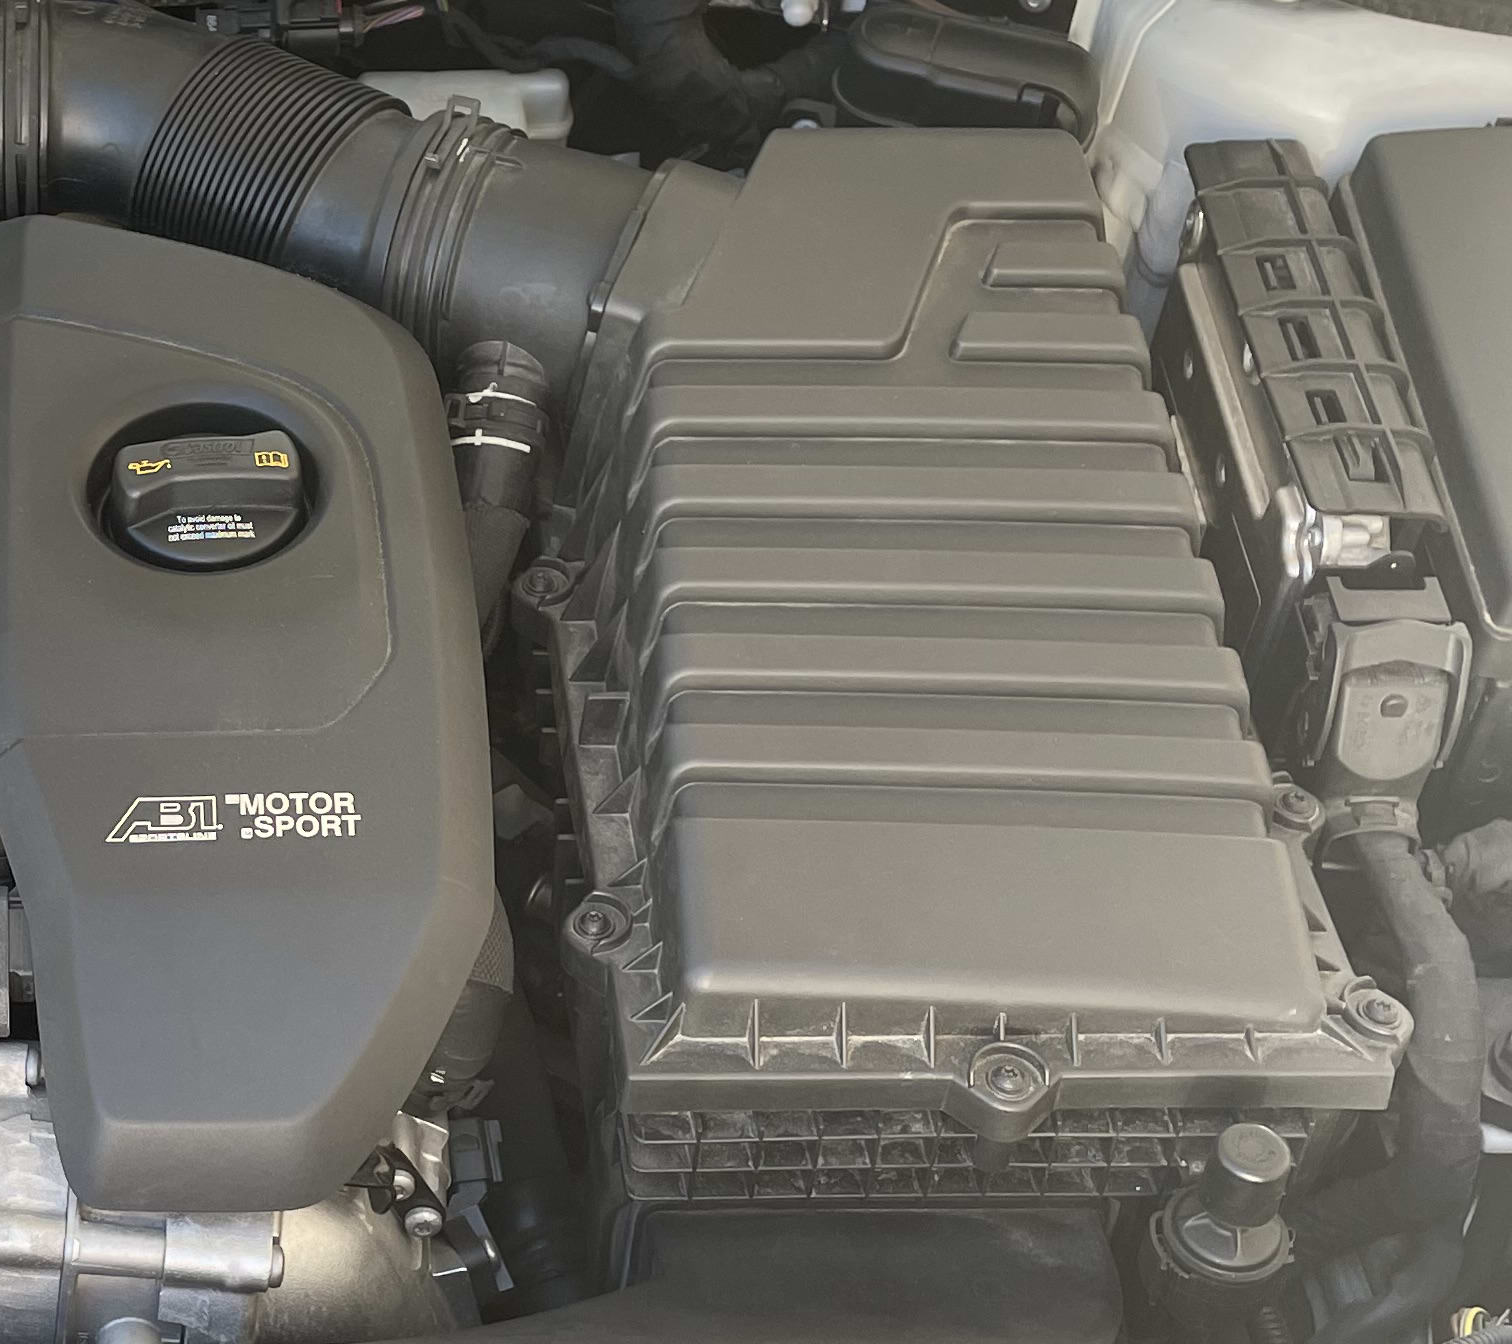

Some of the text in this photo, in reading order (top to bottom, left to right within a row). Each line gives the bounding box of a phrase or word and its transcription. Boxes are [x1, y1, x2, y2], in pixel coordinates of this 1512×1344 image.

[177, 515, 187, 523] To
[240, 792, 356, 815] MOTOR
[253, 814, 362, 838] SPORT
